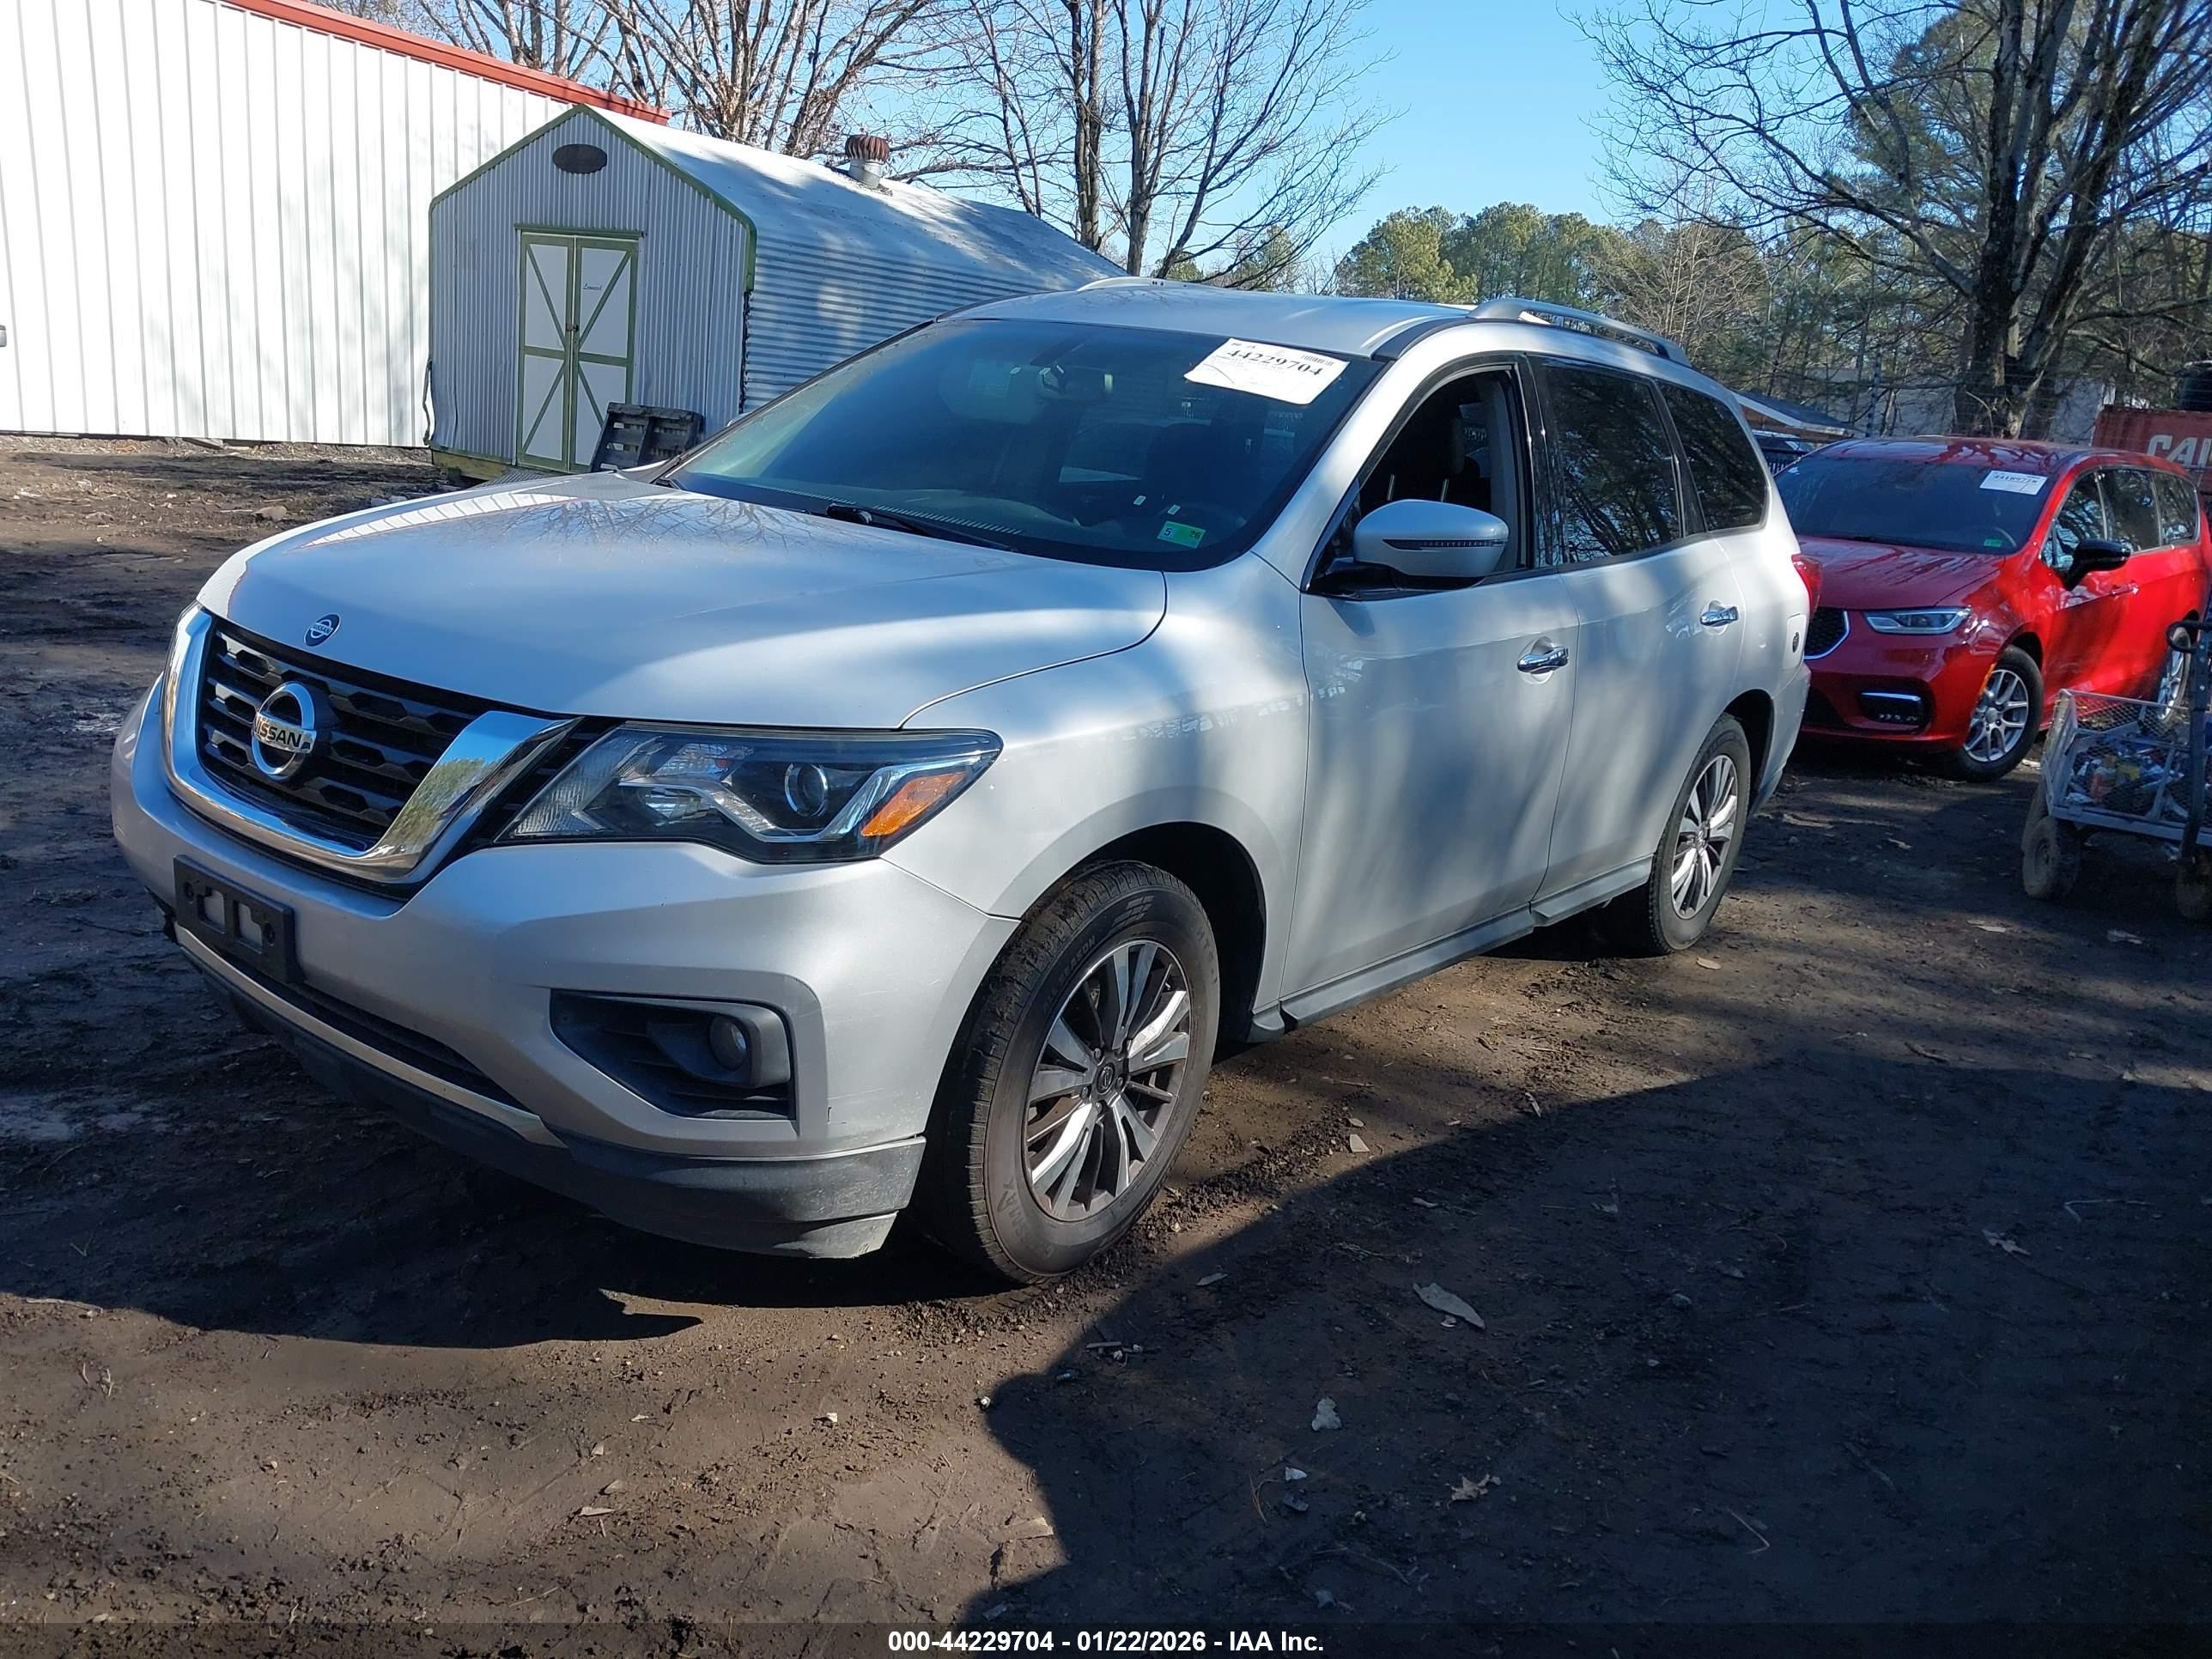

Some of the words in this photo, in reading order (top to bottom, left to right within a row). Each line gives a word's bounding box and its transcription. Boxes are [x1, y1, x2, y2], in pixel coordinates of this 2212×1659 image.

[1226, 349, 1323, 376] 44229704
[1164, 527, 1173, 537] 5
[1188, 530, 1202, 539] 26
[313, 623, 332, 635] NISSAN
[254, 714, 302, 748] NISSAN
[1059, 934, 1096, 987] SEASON
